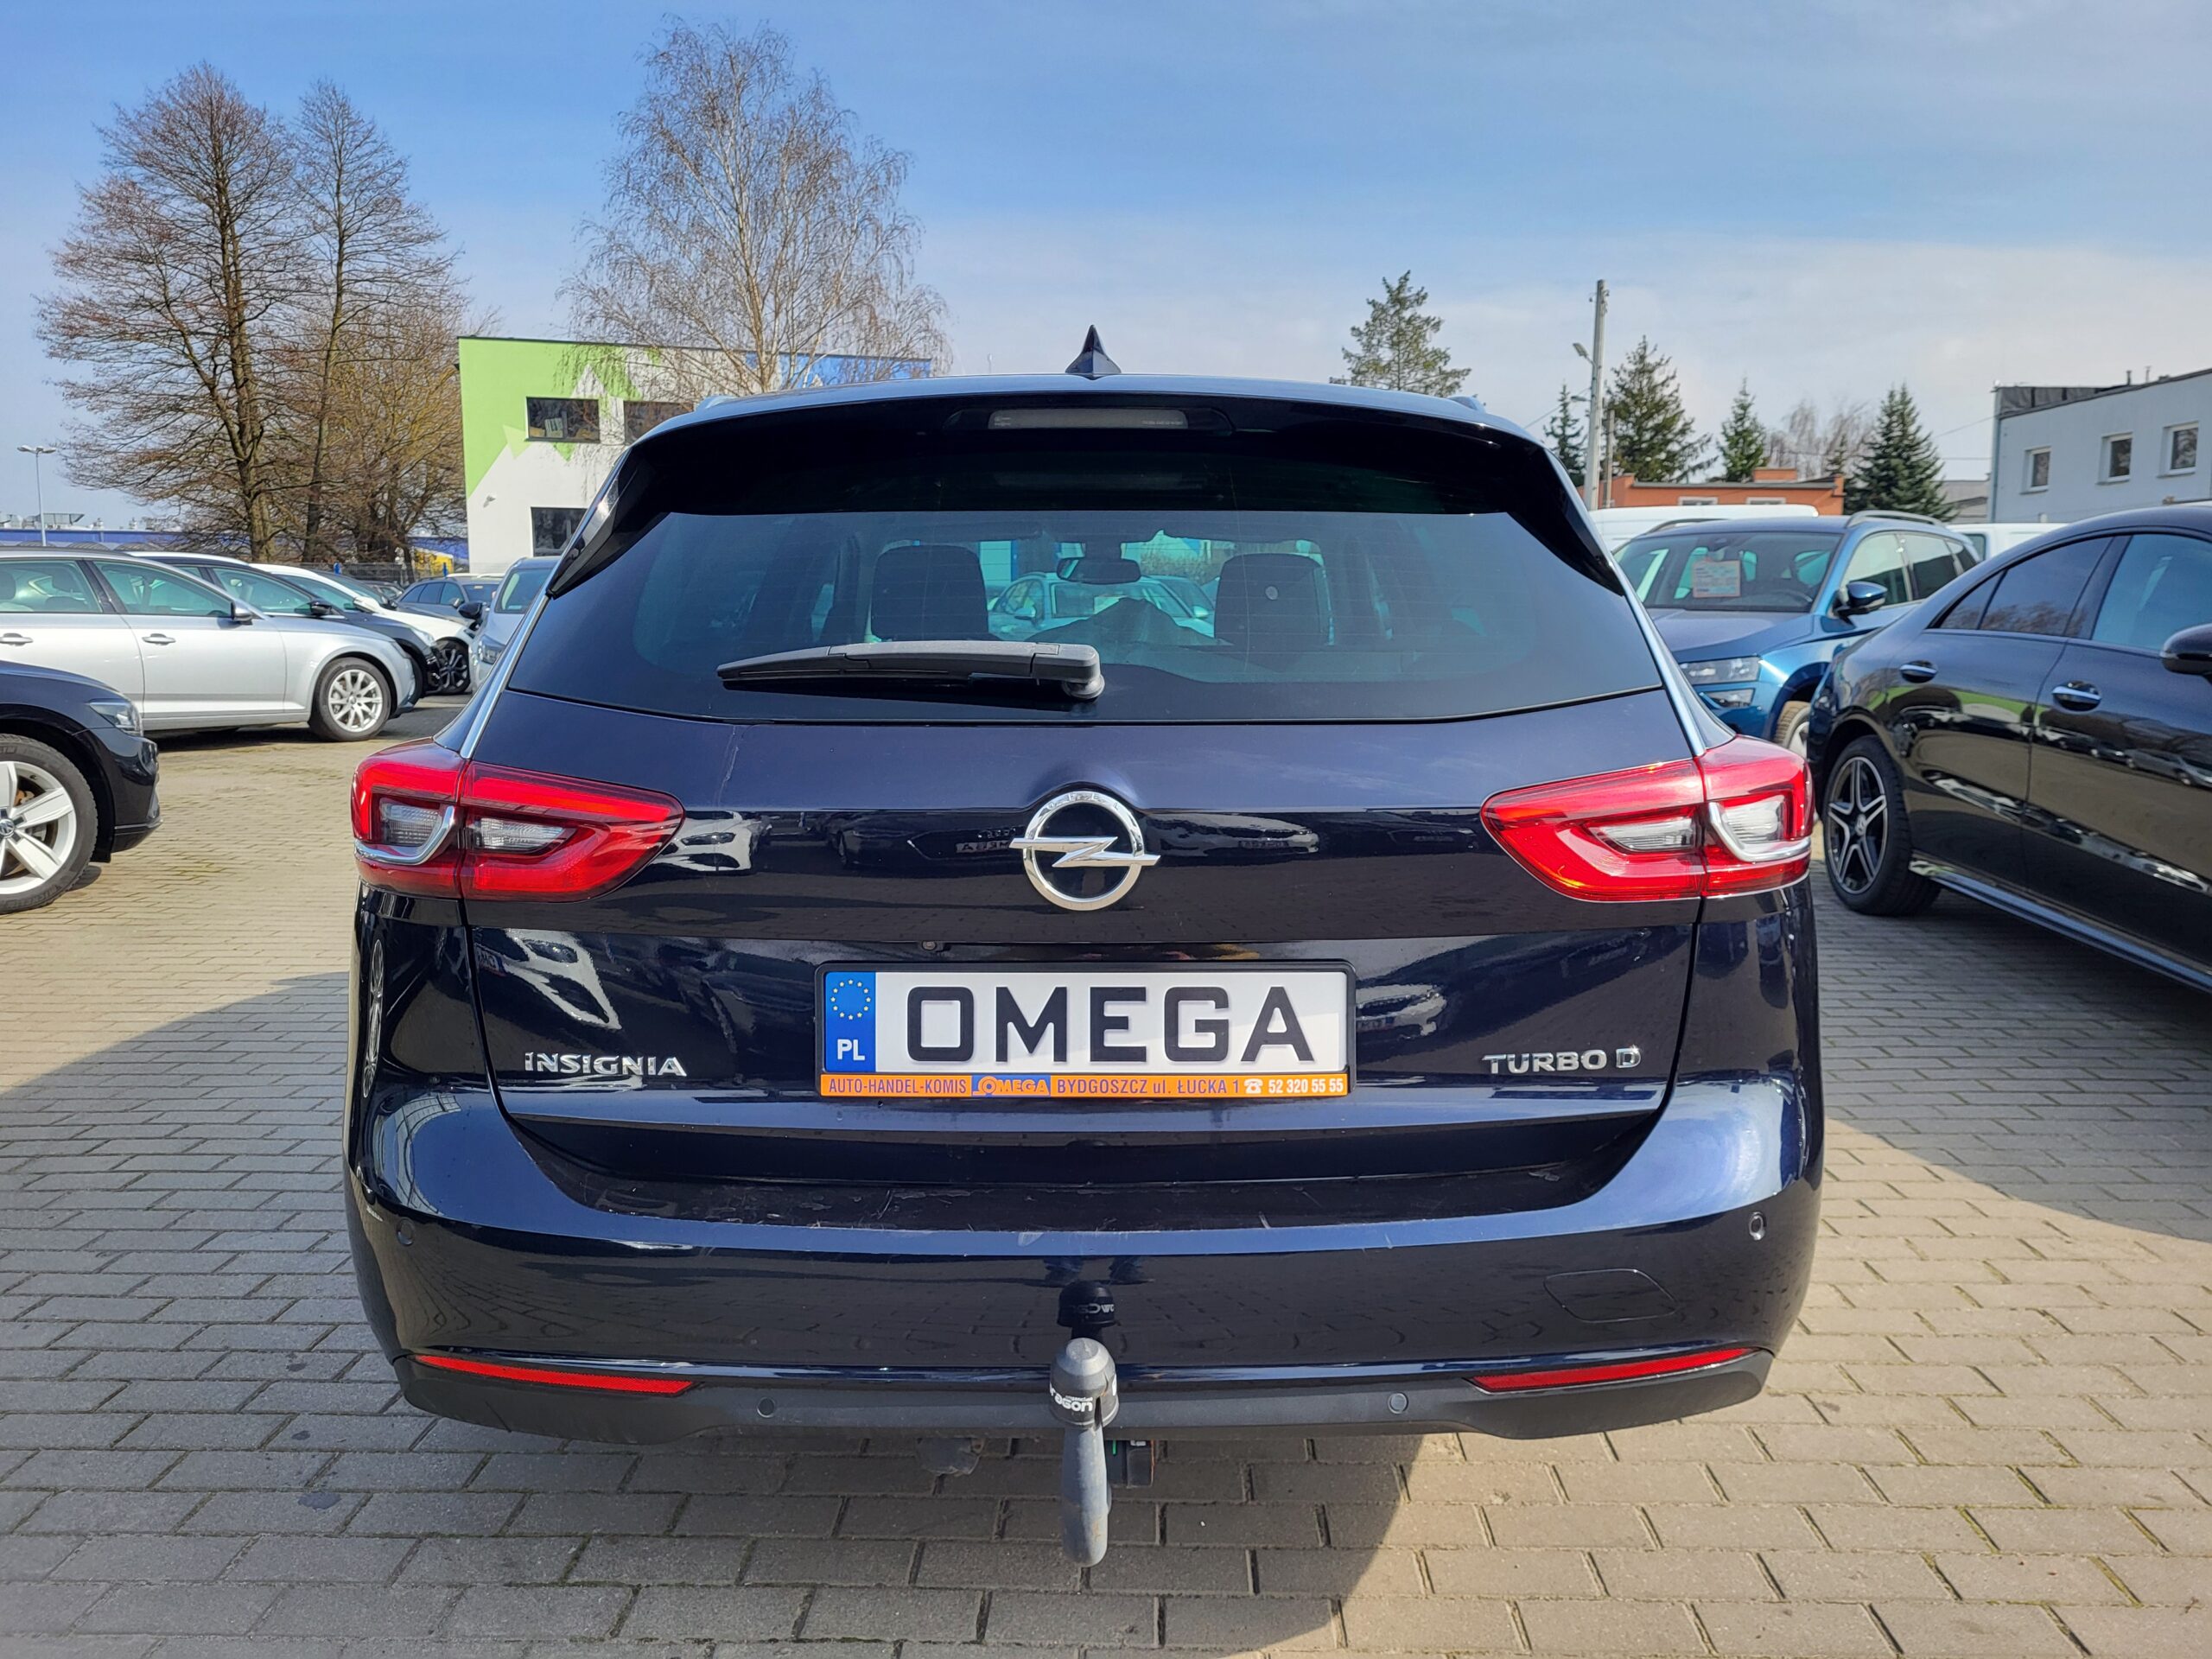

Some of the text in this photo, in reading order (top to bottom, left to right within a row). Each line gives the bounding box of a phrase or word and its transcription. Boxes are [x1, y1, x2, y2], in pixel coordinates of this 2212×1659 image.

[906, 986, 1314, 1062] OMEGA
[837, 1039, 865, 1061] PL
[1482, 1046, 1641, 1074] TURBO D
[524, 1052, 687, 1077] INSIGNIA
[829, 1076, 1344, 1096] AUTO-HANDEL-KOMIS OMEGA BYDGOSZCZ ul. ŁUCKA 1 52 320 55 55
